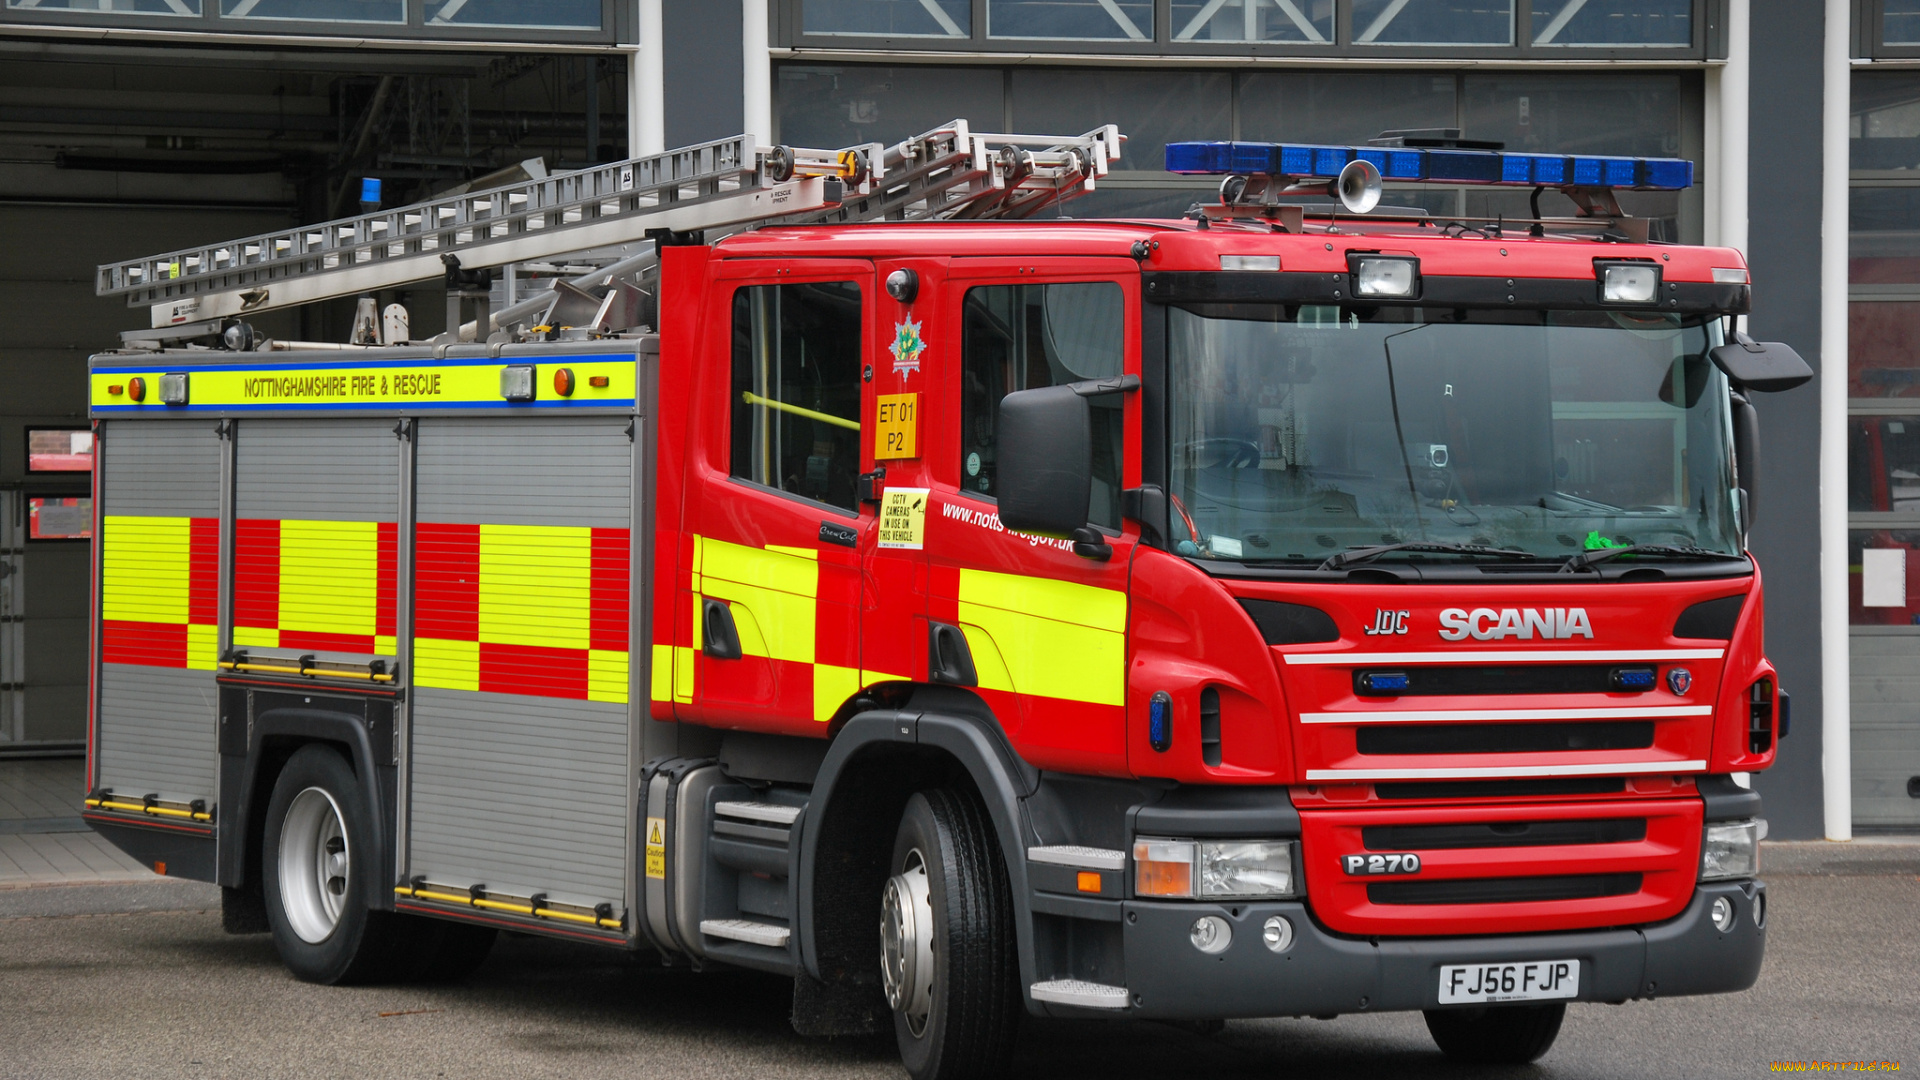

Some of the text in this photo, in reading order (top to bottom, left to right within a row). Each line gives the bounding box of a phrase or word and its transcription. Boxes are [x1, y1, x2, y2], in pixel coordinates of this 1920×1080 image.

[775, 189, 792, 197] RESCUE
[244, 373, 441, 398] NOTTINGHAMSHIRE FIRE & RESCUE
[879, 402, 913, 423] ET 01
[887, 431, 903, 451] P2
[892, 494, 907, 504] CCTV
[885, 505, 910, 517] CAMERAS
[883, 518, 910, 529] IN USE ON
[879, 530, 913, 541] THIS VEHICLE
[1438, 608, 1595, 641] SCANIA
[646, 847, 664, 858] Caution
[1450, 963, 1569, 996] FJ56 FJP
